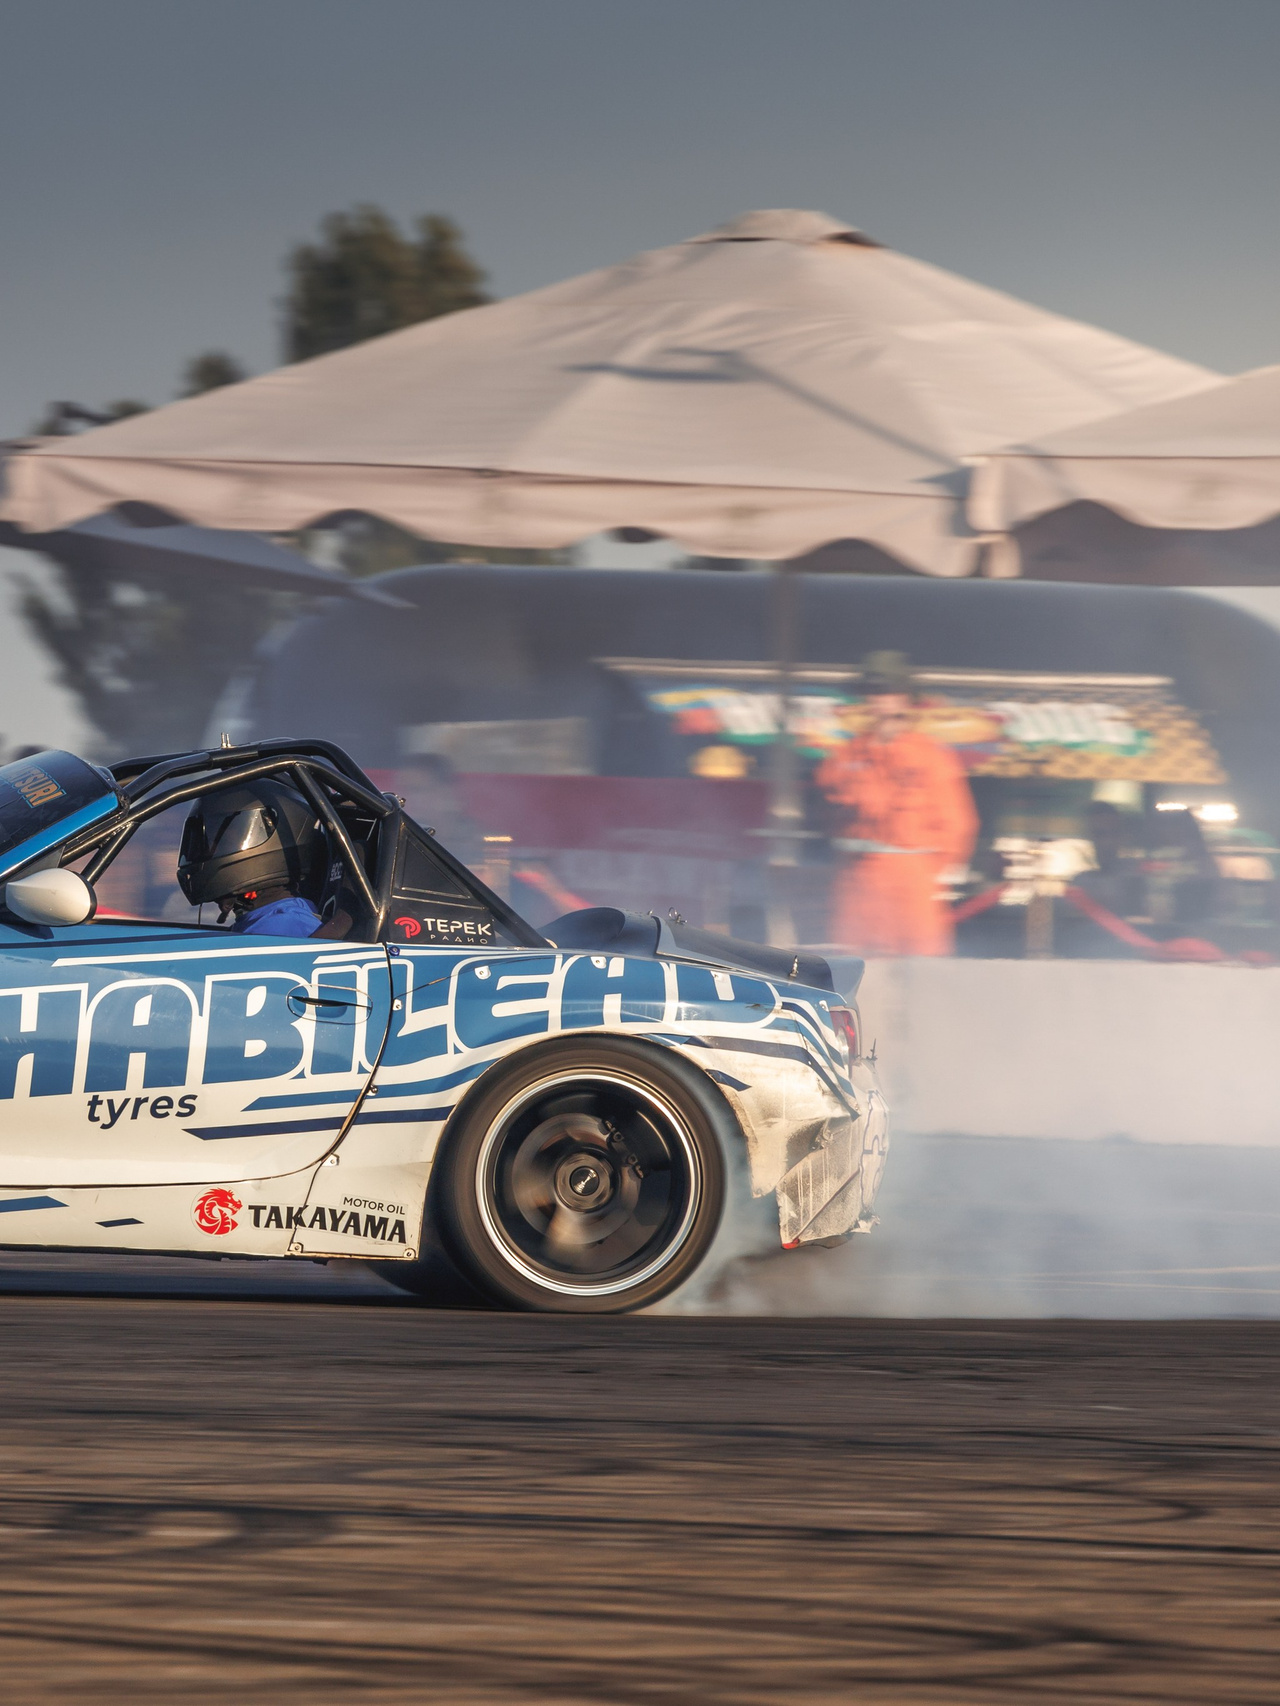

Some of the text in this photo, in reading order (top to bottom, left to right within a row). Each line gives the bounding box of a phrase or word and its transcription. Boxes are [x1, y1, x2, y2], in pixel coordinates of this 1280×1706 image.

[423, 917, 492, 936] ТЕРЕК
[430, 934, 488, 945] РАДИО
[87, 1094, 198, 1130] tyres
[343, 1197, 406, 1216] MOTOR OIL
[248, 1204, 407, 1244] TAKAYAMA
